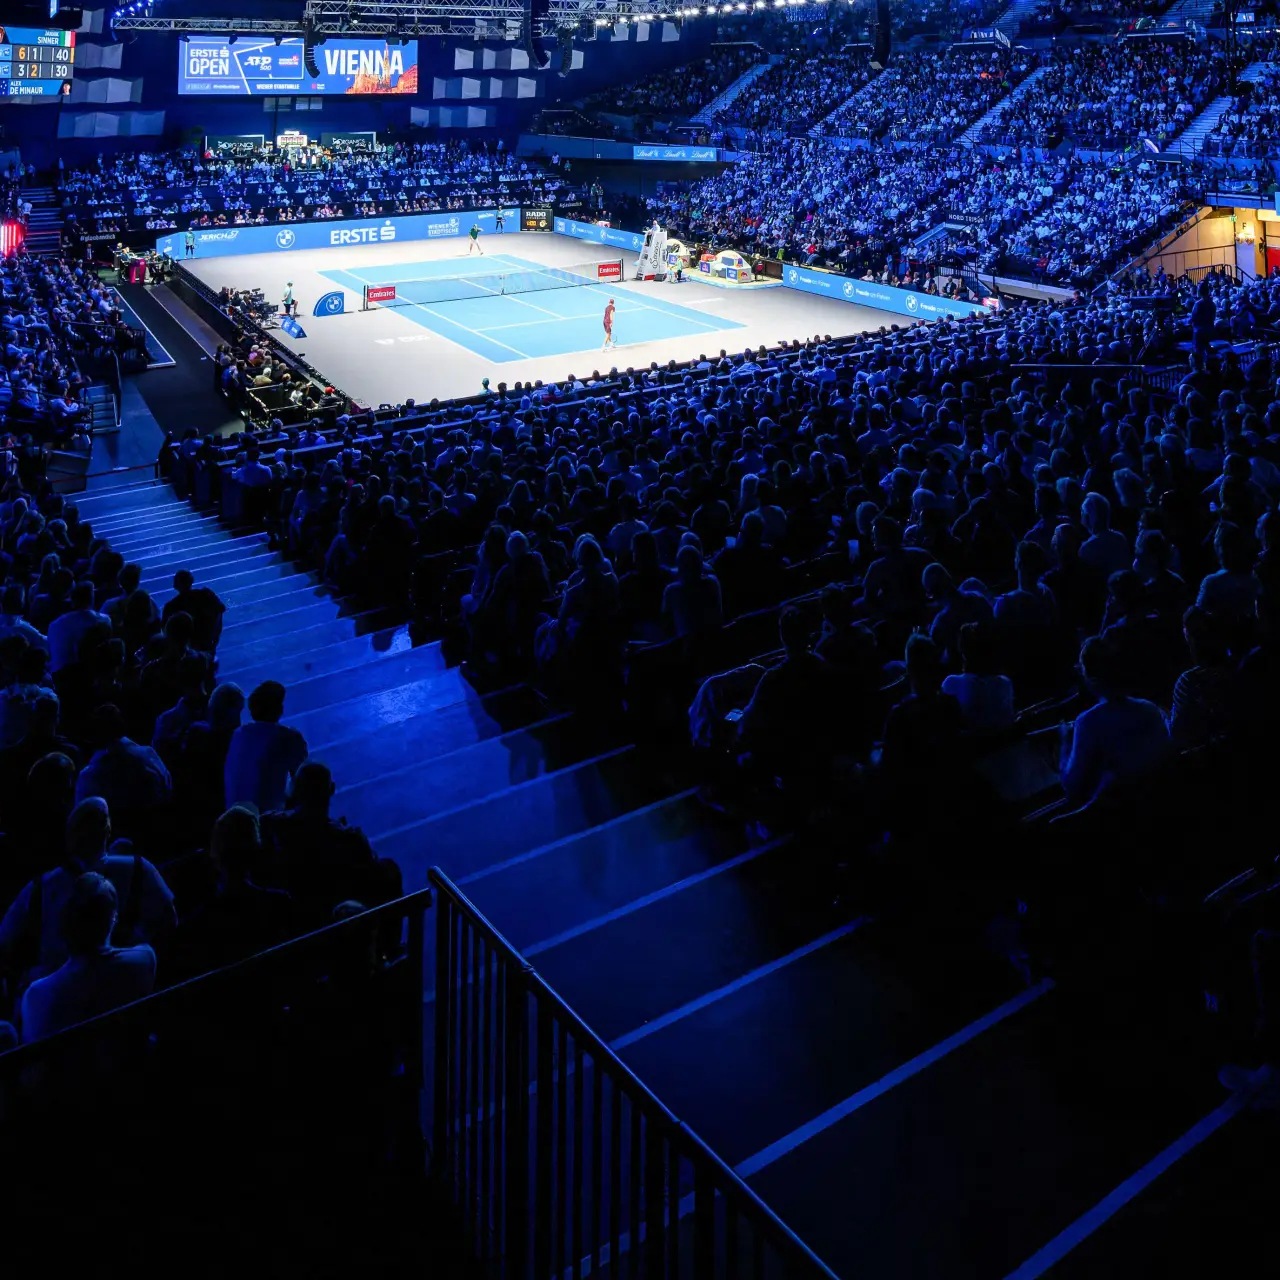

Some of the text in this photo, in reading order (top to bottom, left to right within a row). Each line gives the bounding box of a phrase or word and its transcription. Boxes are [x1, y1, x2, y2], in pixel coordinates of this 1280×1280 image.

[37, 36, 59, 45] SINNER
[18, 47, 26, 60] 6
[32, 48, 37, 60] 1
[56, 49, 69, 61] 40
[190, 49, 218, 58] ERSTE
[189, 58, 229, 75] OPEN
[244, 56, 272, 66] ATP
[324, 49, 404, 75] VIENNA
[18, 64, 25, 77] 3
[30, 64, 37, 77] 2
[55, 65, 68, 77] 30
[9, 86, 43, 95] DE MINAUR
[330, 227, 378, 244] ERSTE
